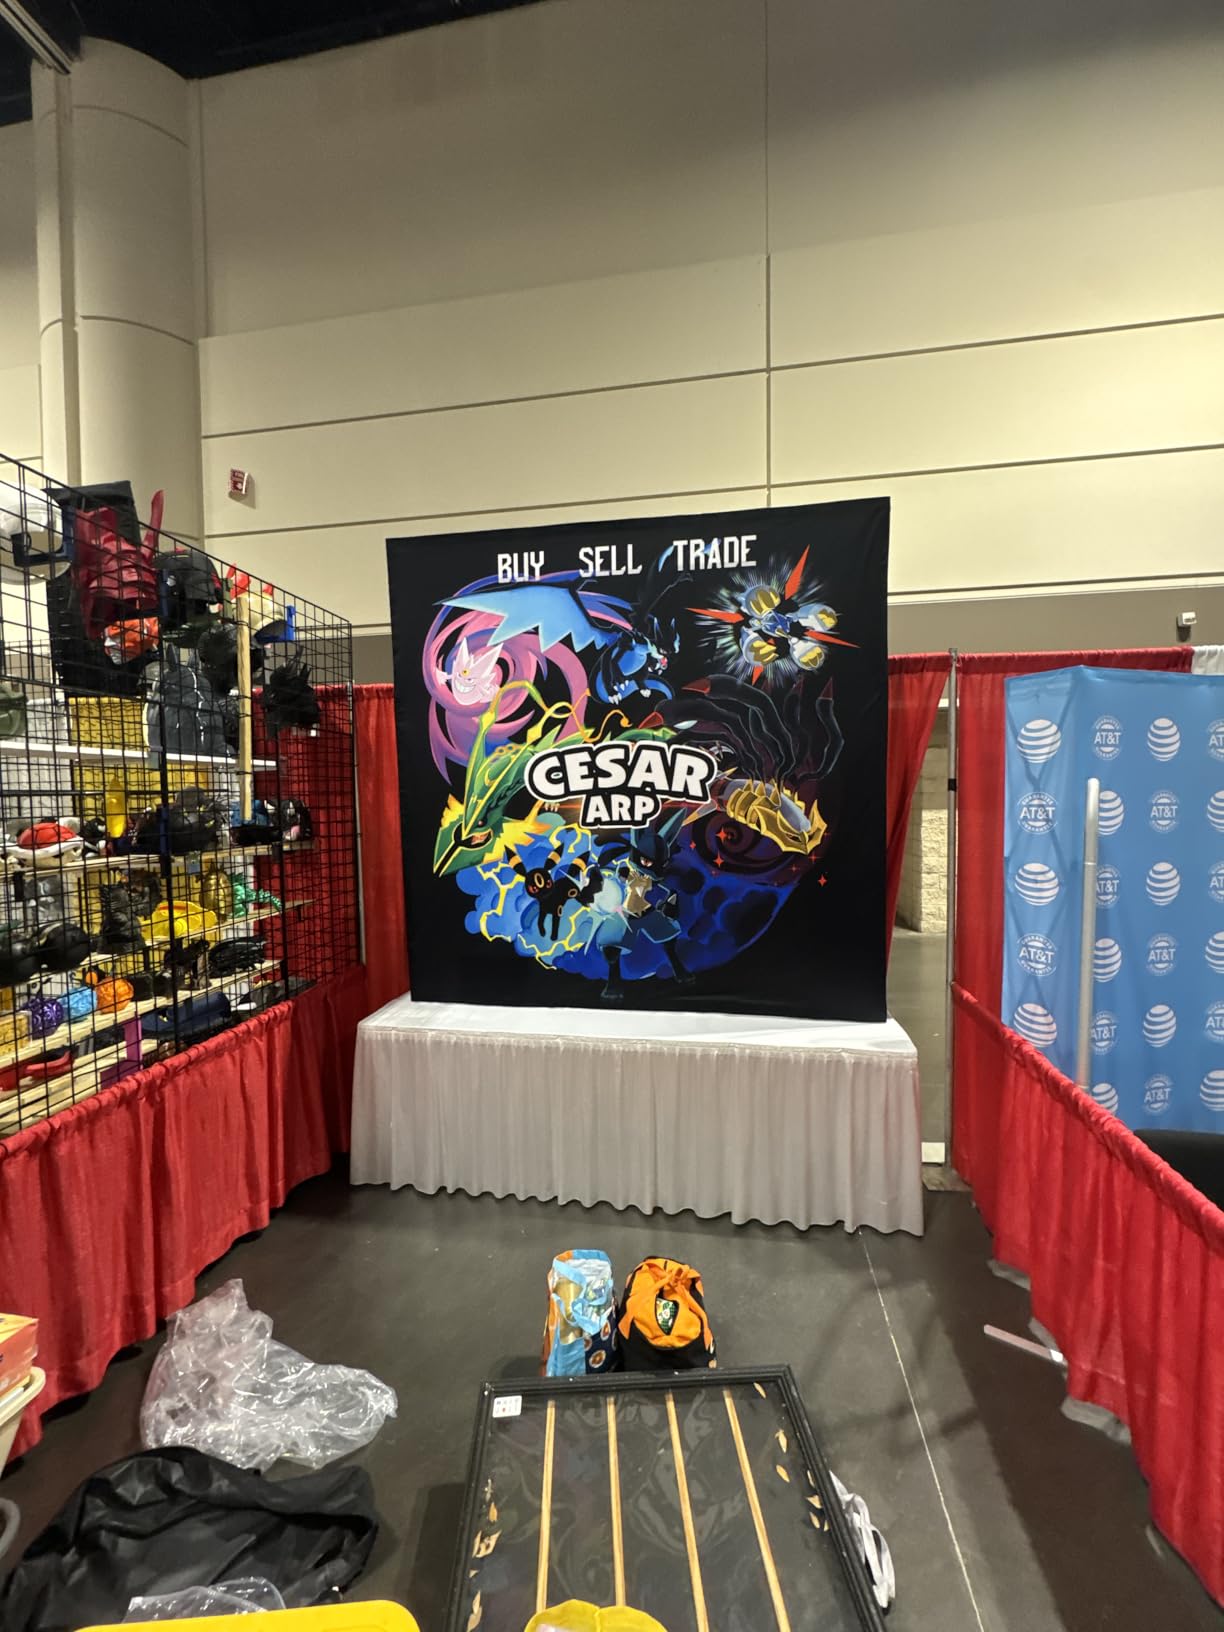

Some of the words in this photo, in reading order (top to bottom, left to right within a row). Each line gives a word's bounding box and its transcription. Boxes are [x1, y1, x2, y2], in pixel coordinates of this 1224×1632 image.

[497, 550, 545, 583] BUY
[578, 543, 643, 578] SELL
[673, 534, 757, 571] TRADE
[1094, 731, 1122, 745] AT&T
[532, 747, 708, 798] CESAR
[585, 794, 655, 824] ARP
[1020, 806, 1056, 820] AT&T
[1150, 805, 1178, 818] AT&T
[1019, 946, 1055, 964] AT&T
[1148, 948, 1176, 962] AT&T
